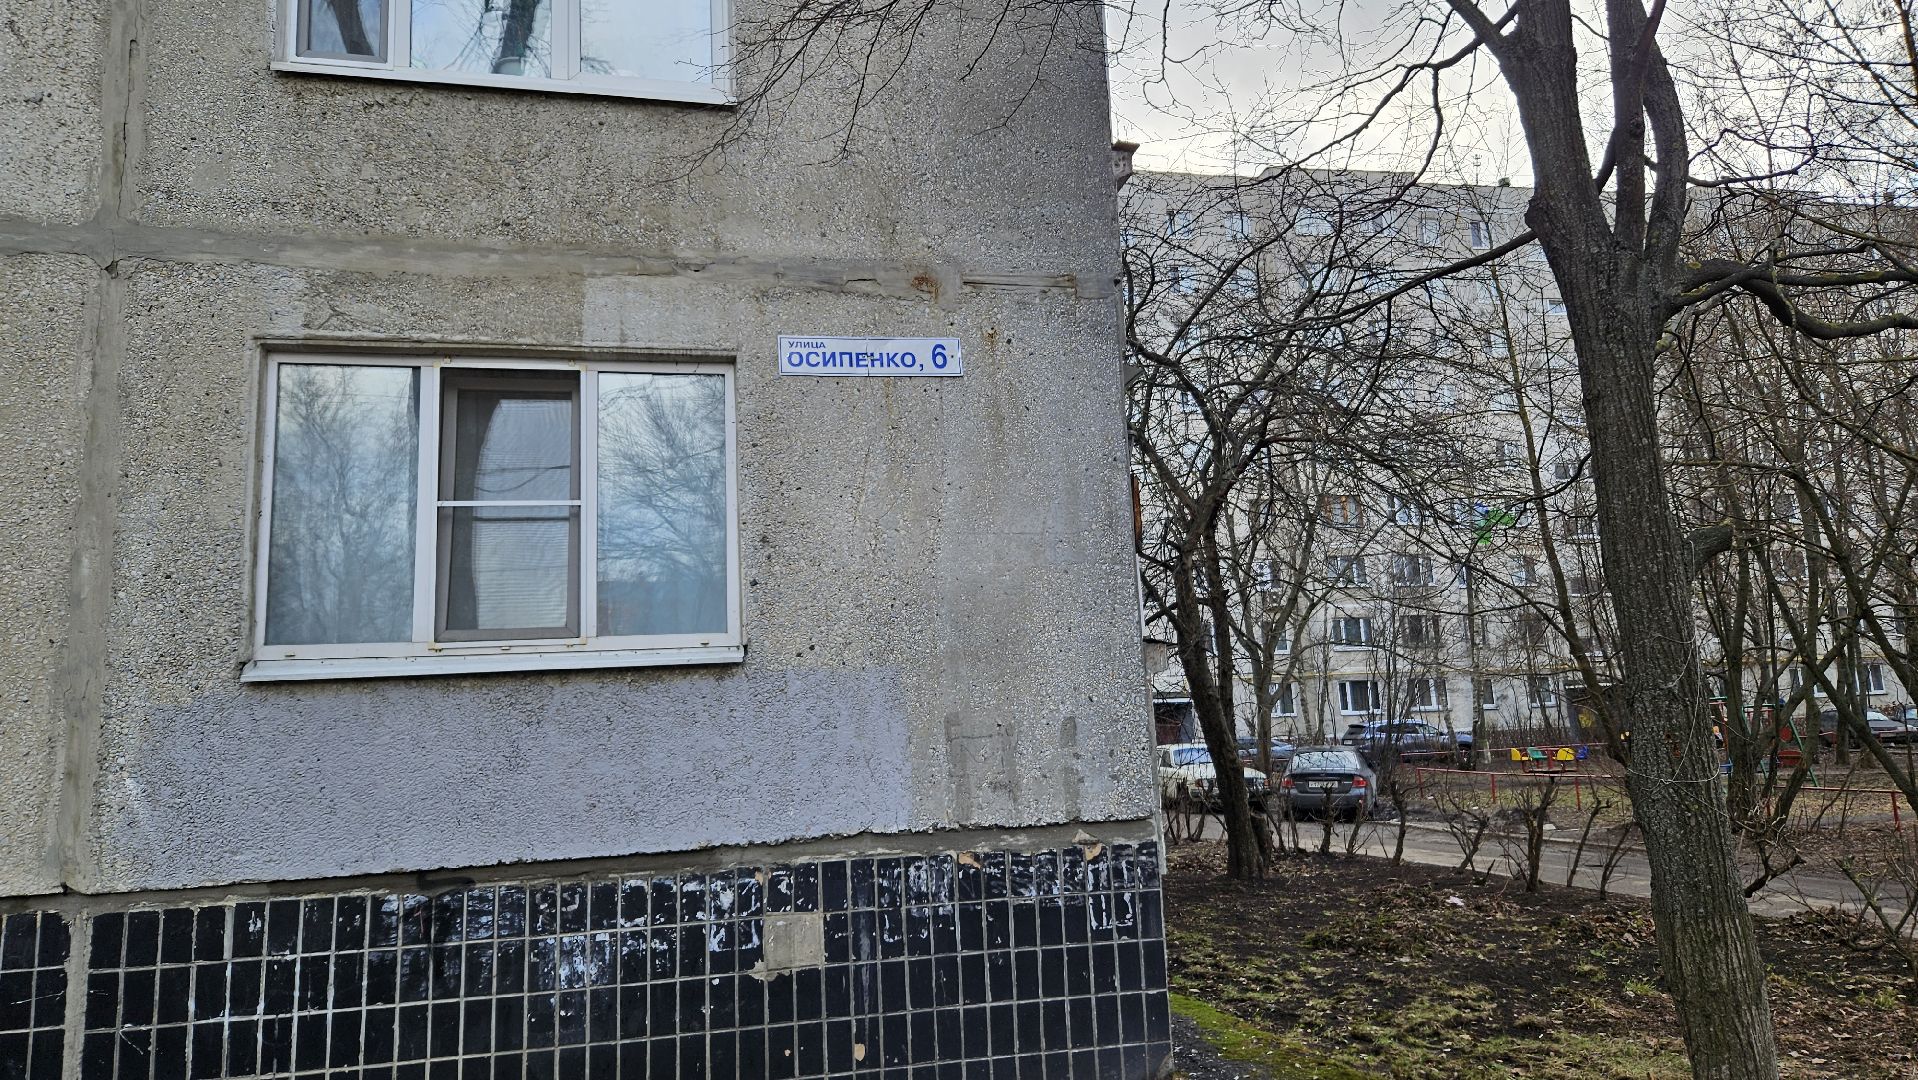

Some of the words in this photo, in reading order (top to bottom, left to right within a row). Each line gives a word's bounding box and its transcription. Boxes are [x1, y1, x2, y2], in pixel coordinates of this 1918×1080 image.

[788, 341, 826, 349] УЛИЦА
[787, 351, 924, 371] ОСИПЕНКО,
[931, 343, 947, 369] 6
